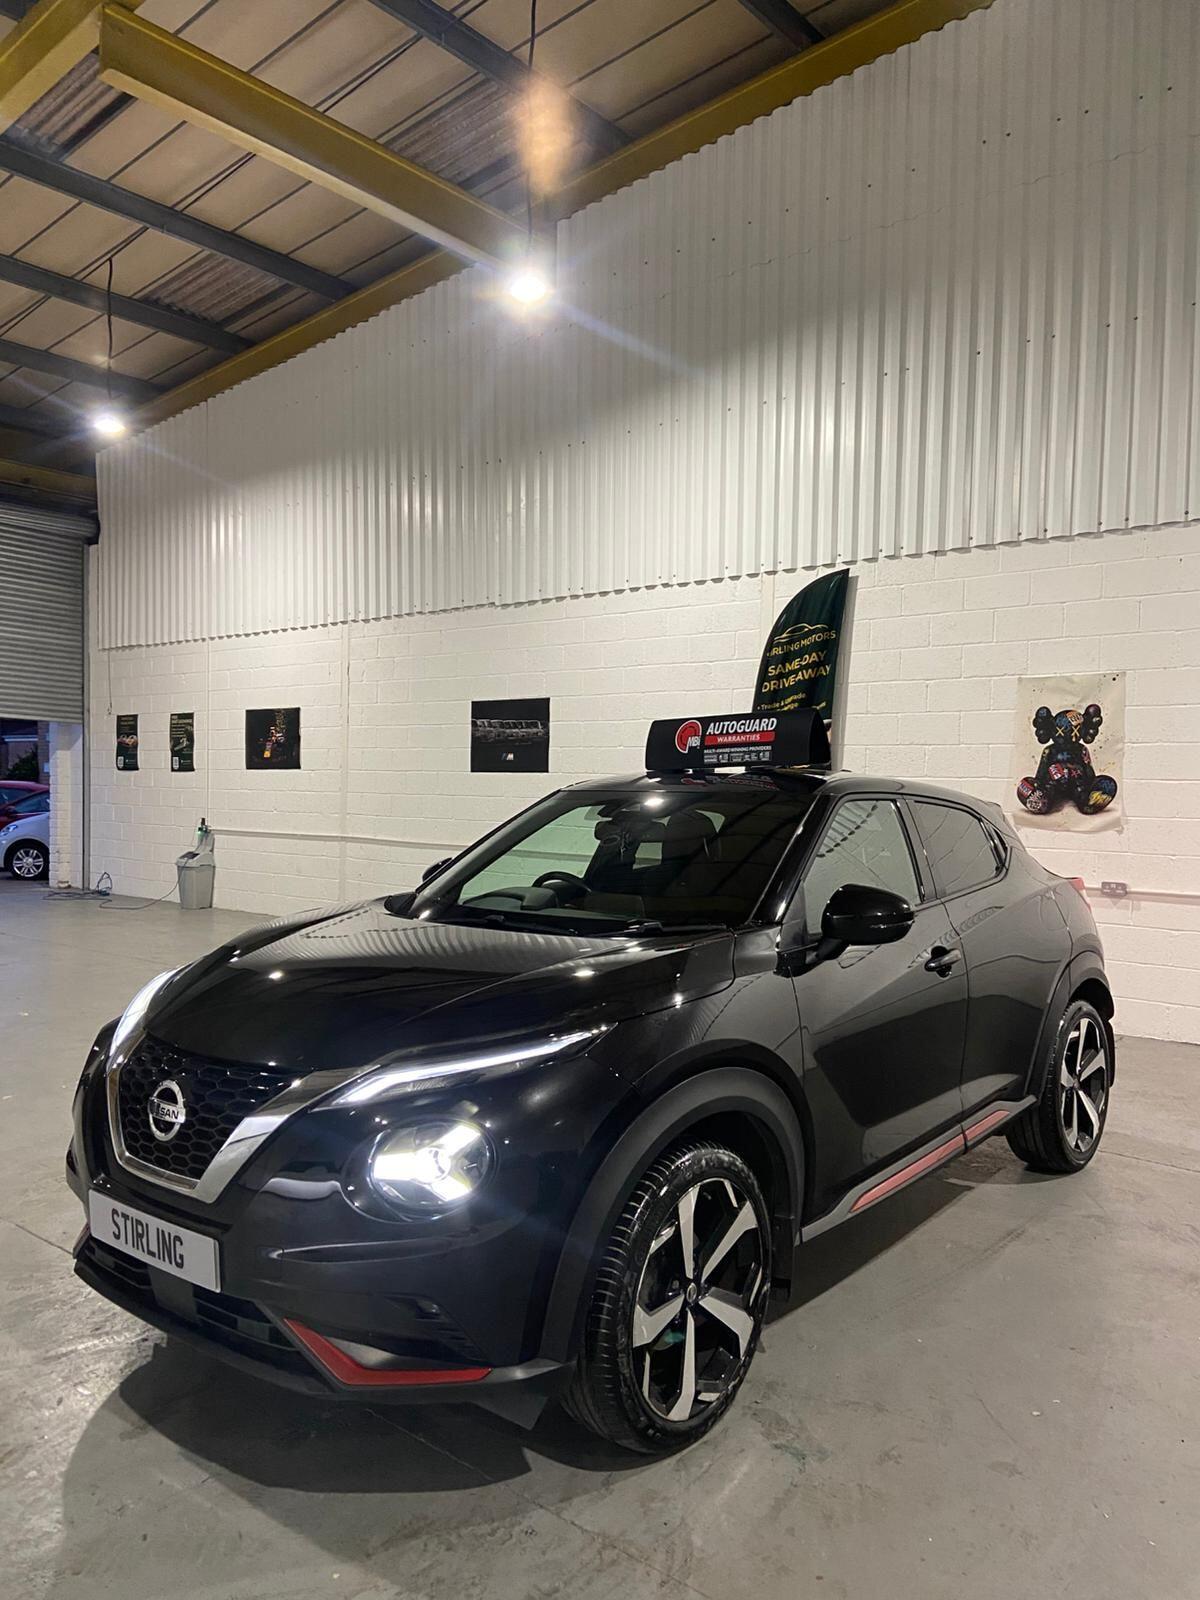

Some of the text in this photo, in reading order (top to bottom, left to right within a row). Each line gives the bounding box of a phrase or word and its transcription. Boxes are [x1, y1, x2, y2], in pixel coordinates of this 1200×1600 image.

[801, 630, 837, 647] MOTORS
[761, 663, 832, 693] DRIVEAWAY
[706, 718, 777, 735] AUTOGUARD
[717, 734, 760, 743] WARRANTIES
[111, 1208, 184, 1269] STIRLING
